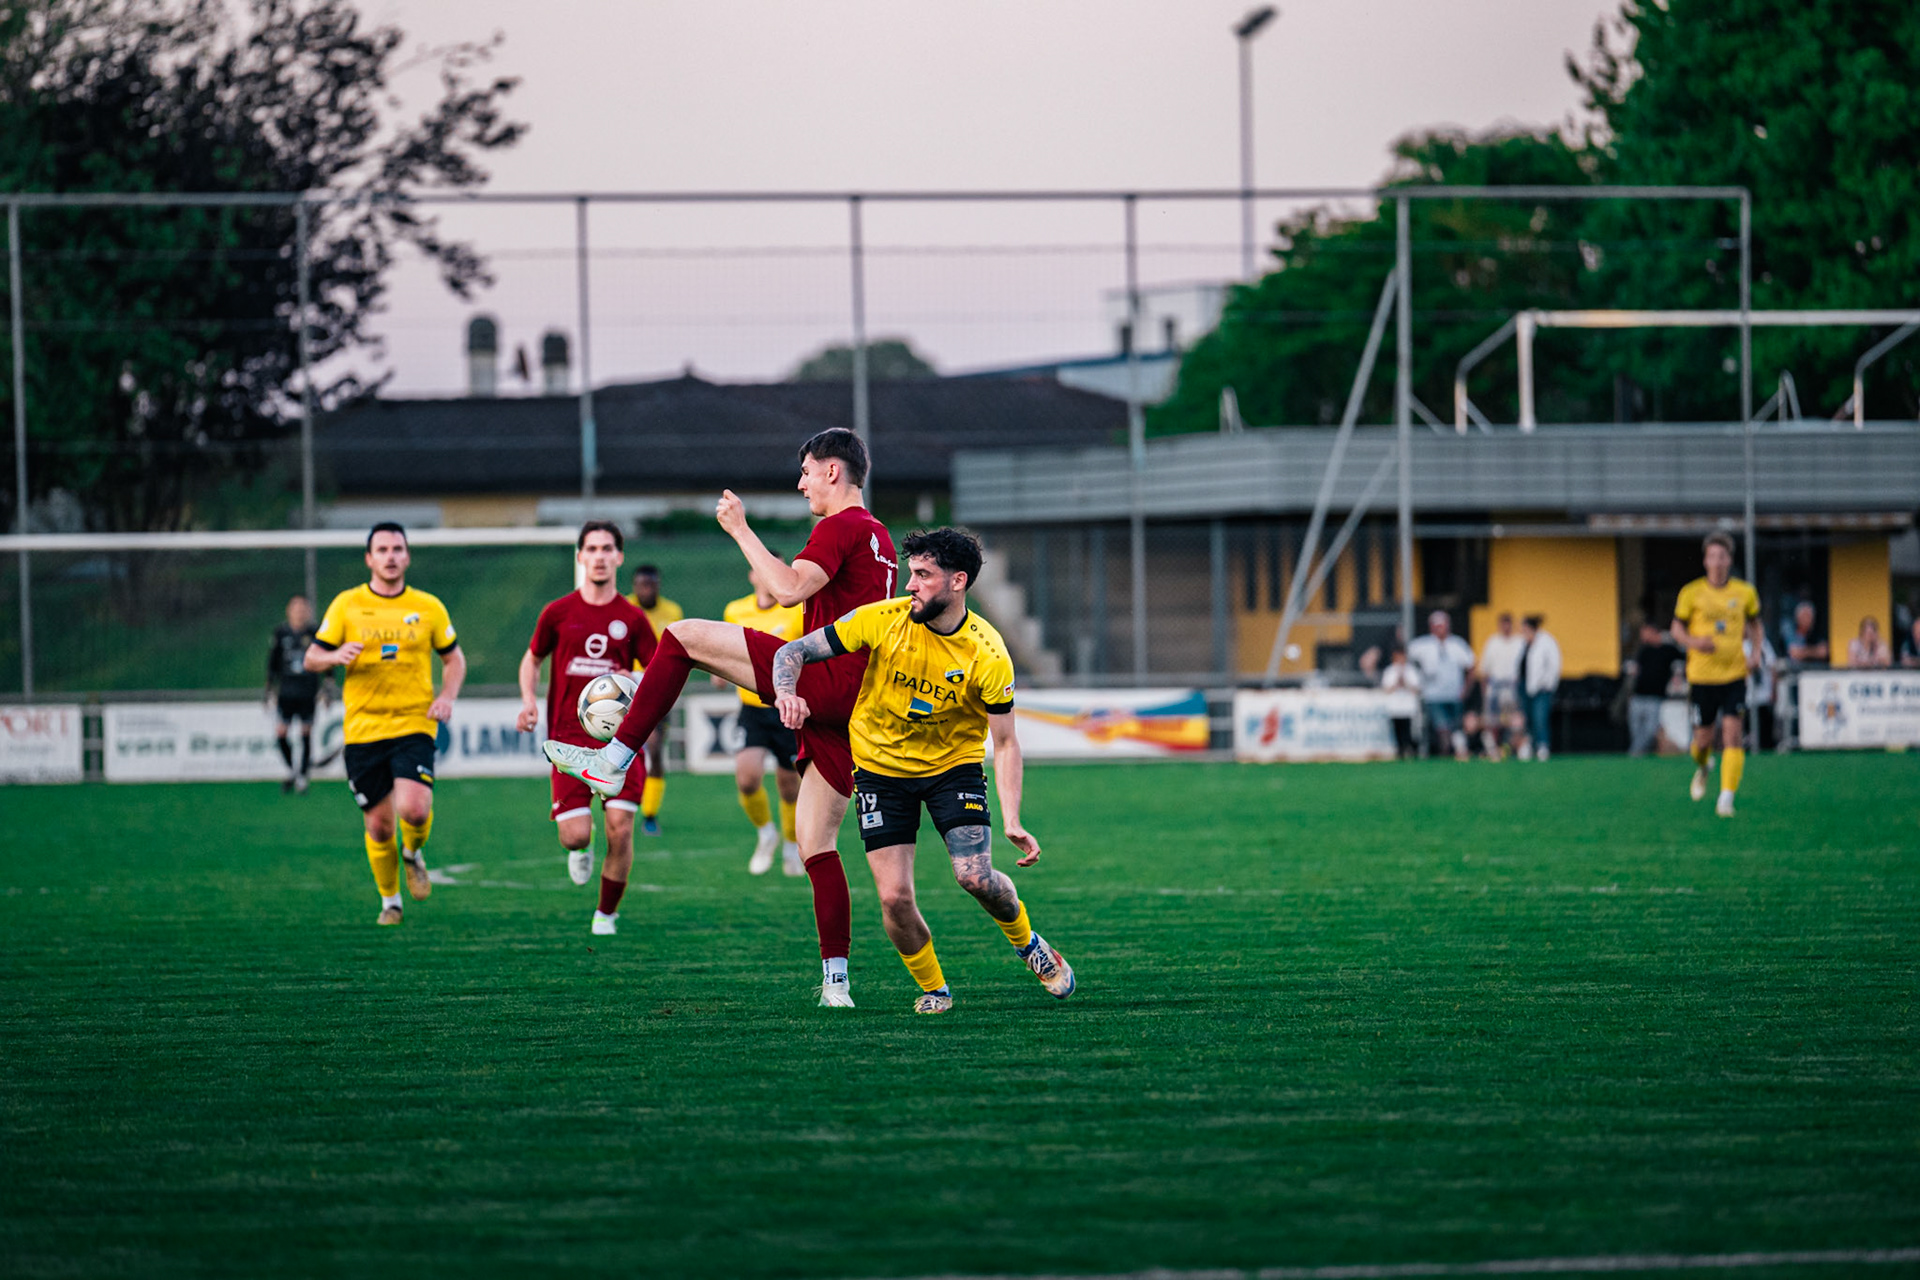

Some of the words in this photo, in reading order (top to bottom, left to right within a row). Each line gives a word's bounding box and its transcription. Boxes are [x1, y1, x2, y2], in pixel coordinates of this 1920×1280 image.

[893, 671, 958, 704] PADEA
[0, 708, 69, 739] ORT
[858, 792, 878, 812] 19
[964, 802, 984, 812] JAKO
